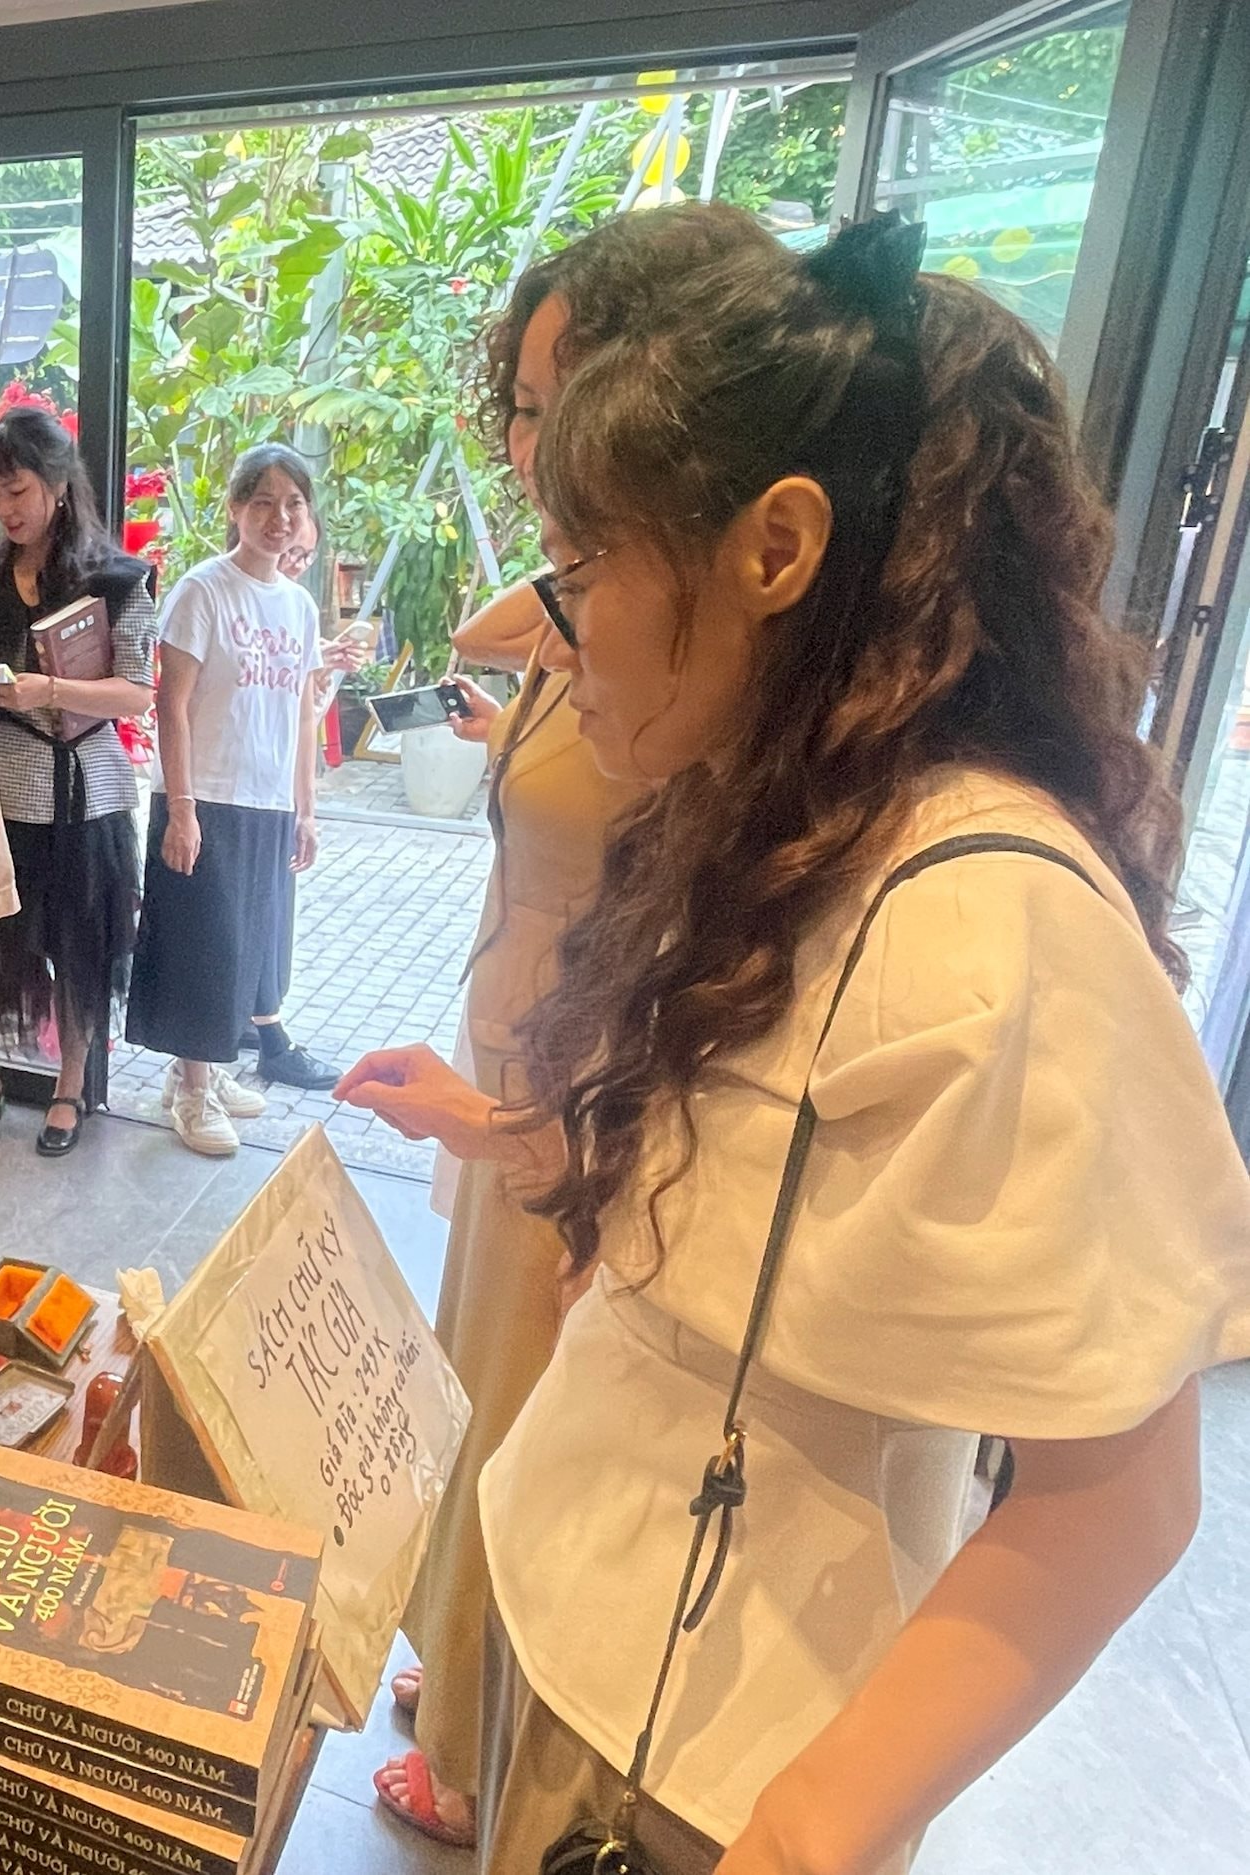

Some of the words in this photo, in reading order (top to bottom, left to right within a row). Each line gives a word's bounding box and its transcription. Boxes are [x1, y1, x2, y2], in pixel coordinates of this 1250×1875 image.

[247, 1298, 294, 1390] SÁCH
[288, 1231, 323, 1312] CHỮ
[316, 1209, 344, 1266] KÝ
[285, 1322, 339, 1418] TÁC
[319, 1426, 342, 1487] Giá
[6, 1498, 77, 1589] NGƯỜI
[34, 1586, 65, 1622] 400
[6, 1698, 46, 1722] CHỮ
[50, 1713, 78, 1734] VÀ
[81, 1722, 143, 1755] NGƯỜI
[145, 1746, 177, 1768] 400
[4, 1736, 44, 1760] CHỮ
[48, 1750, 75, 1772] VÀ
[79, 1760, 139, 1793] NGƯỜI
[142, 1784, 173, 1805] 400
[31, 1790, 59, 1813] VÀ
[62, 1803, 121, 1838] NGƯỜI
[123, 1831, 154, 1852] 400
[38, 1825, 64, 1850] VÀ
[68, 1839, 125, 1874] NGƯỜI
